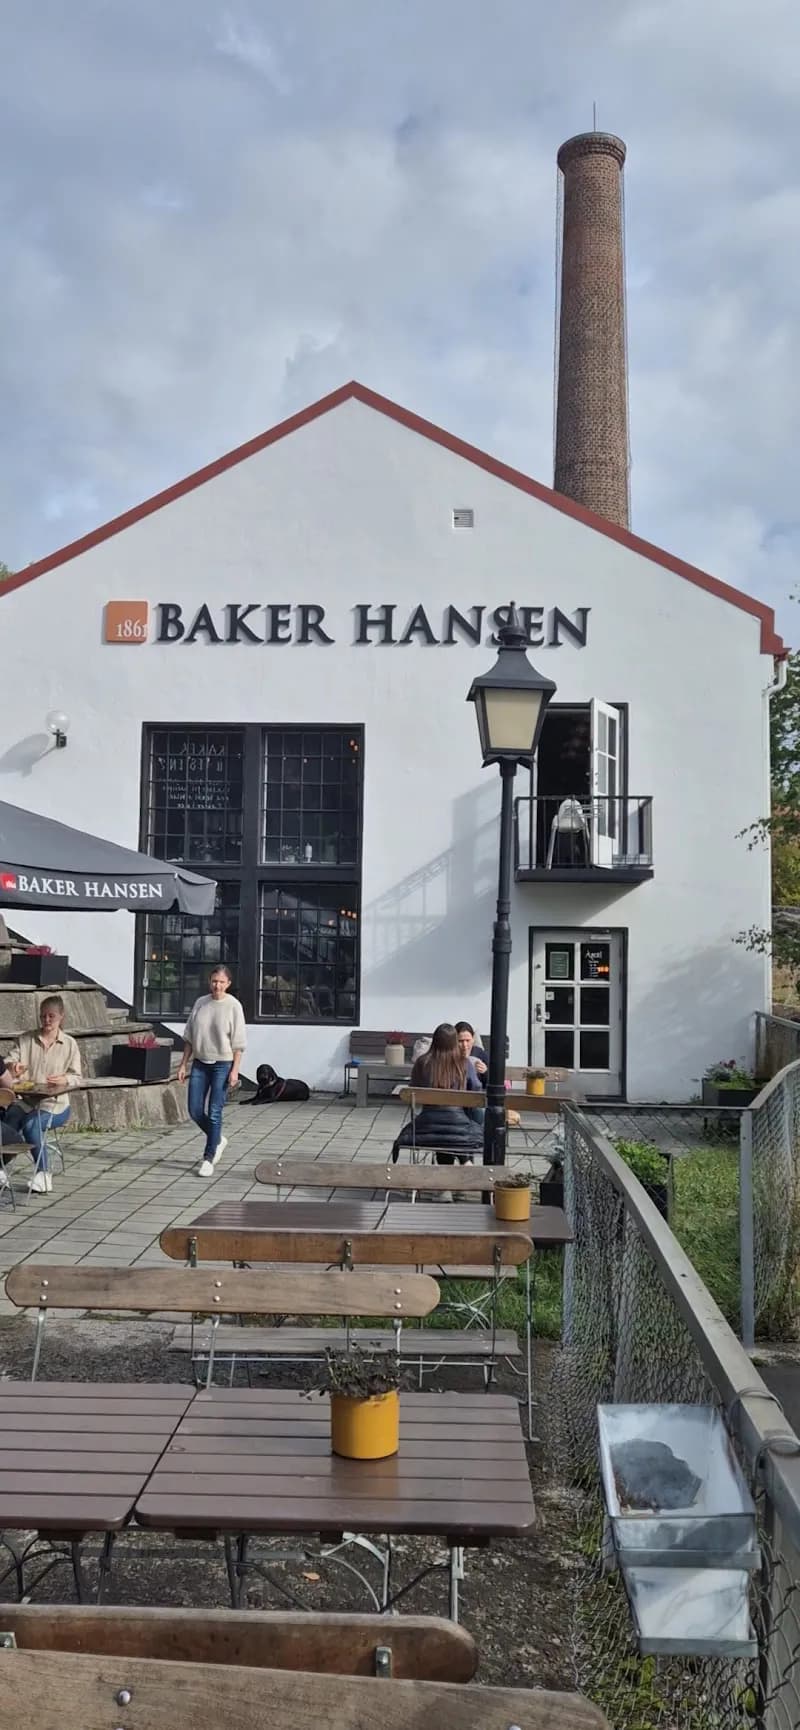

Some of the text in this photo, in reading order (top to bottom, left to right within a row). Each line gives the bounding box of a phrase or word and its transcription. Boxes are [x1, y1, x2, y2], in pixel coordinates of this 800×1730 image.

[156, 603, 336, 644] BAKER
[18, 875, 79, 897] BAKER
[84, 881, 163, 898] HANSEN
